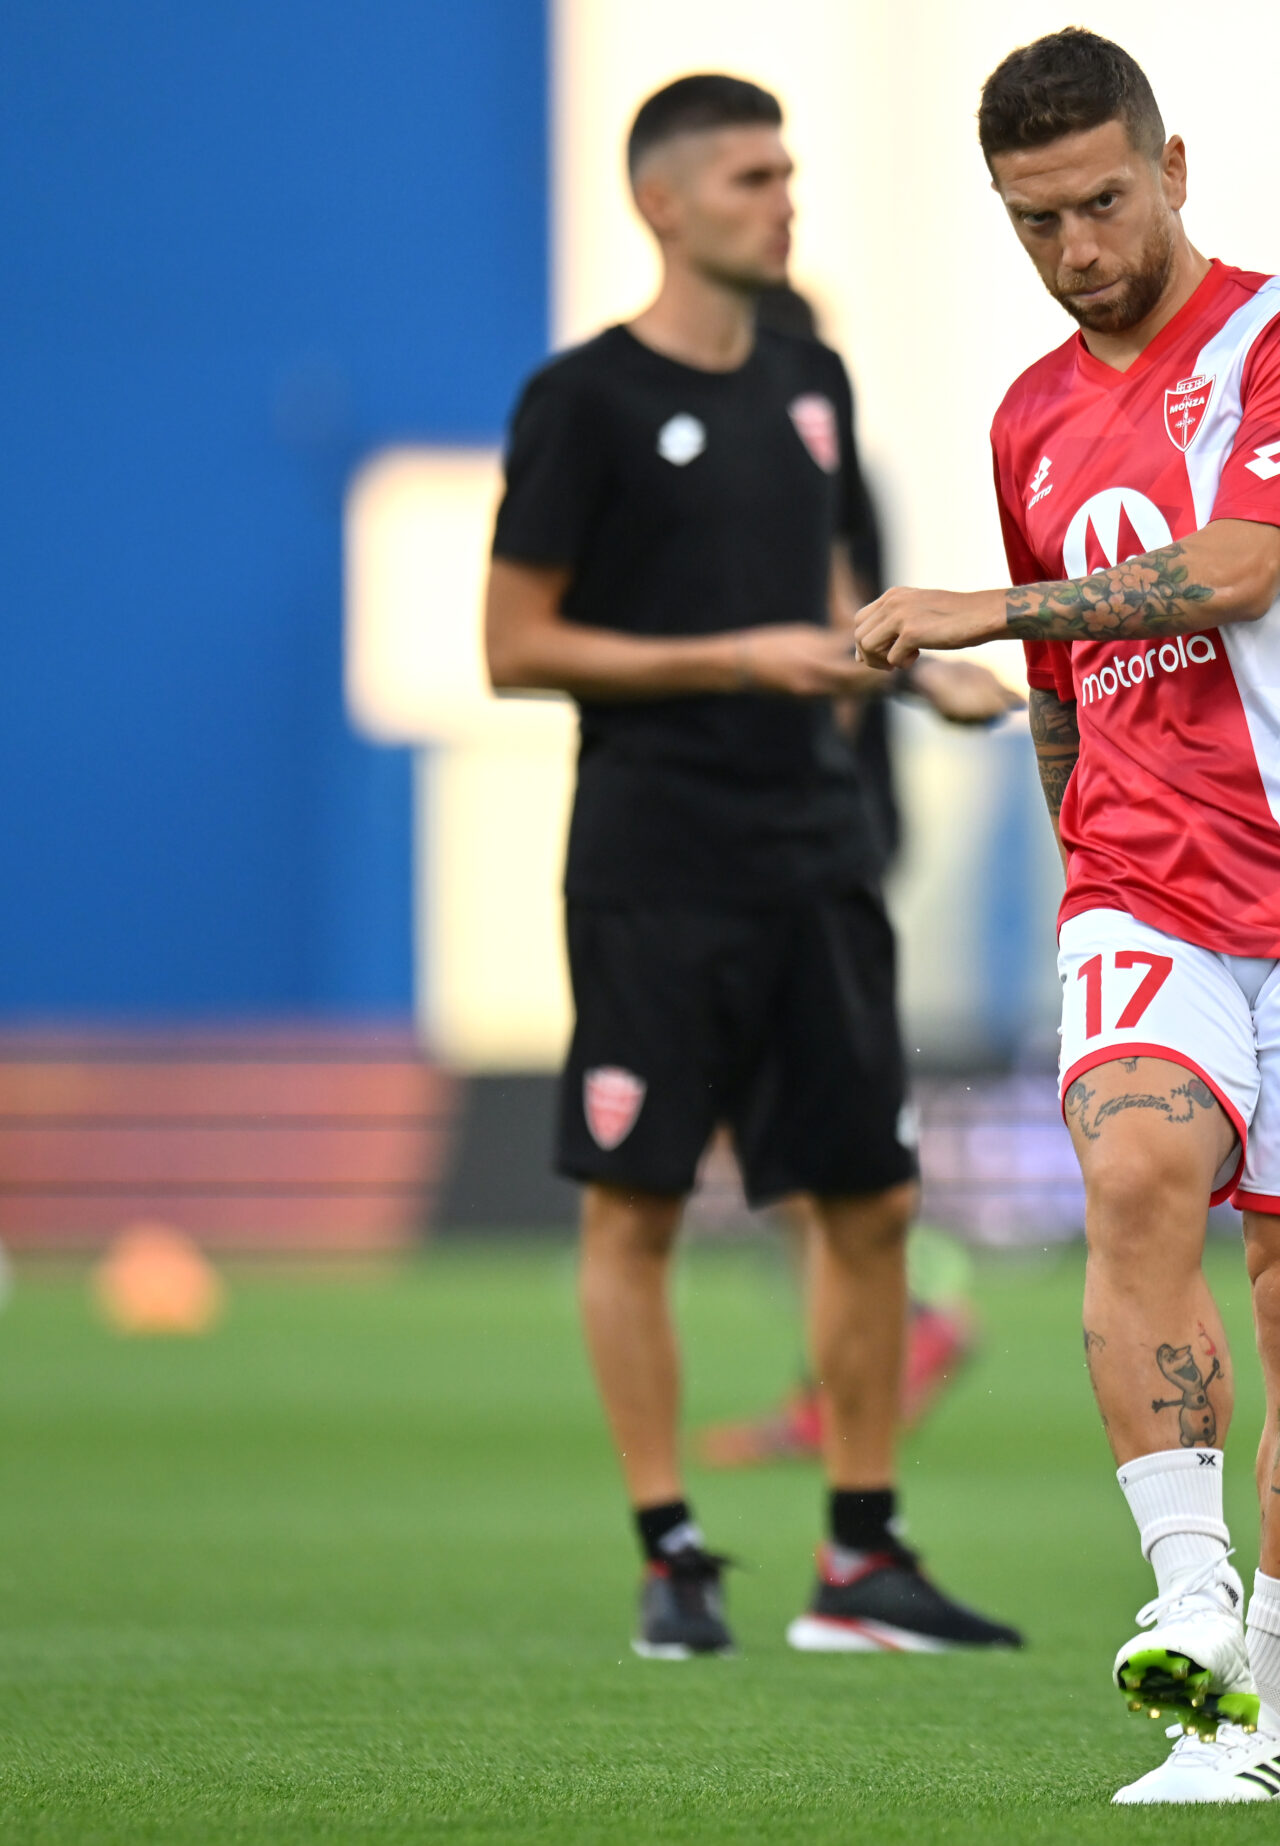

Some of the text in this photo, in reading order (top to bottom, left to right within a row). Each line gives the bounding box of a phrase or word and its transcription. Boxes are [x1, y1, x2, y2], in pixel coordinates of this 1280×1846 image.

[1169, 396, 1205, 415] MONZA
[1082, 635, 1217, 707] motorola
[1077, 950, 1174, 1040] 17
